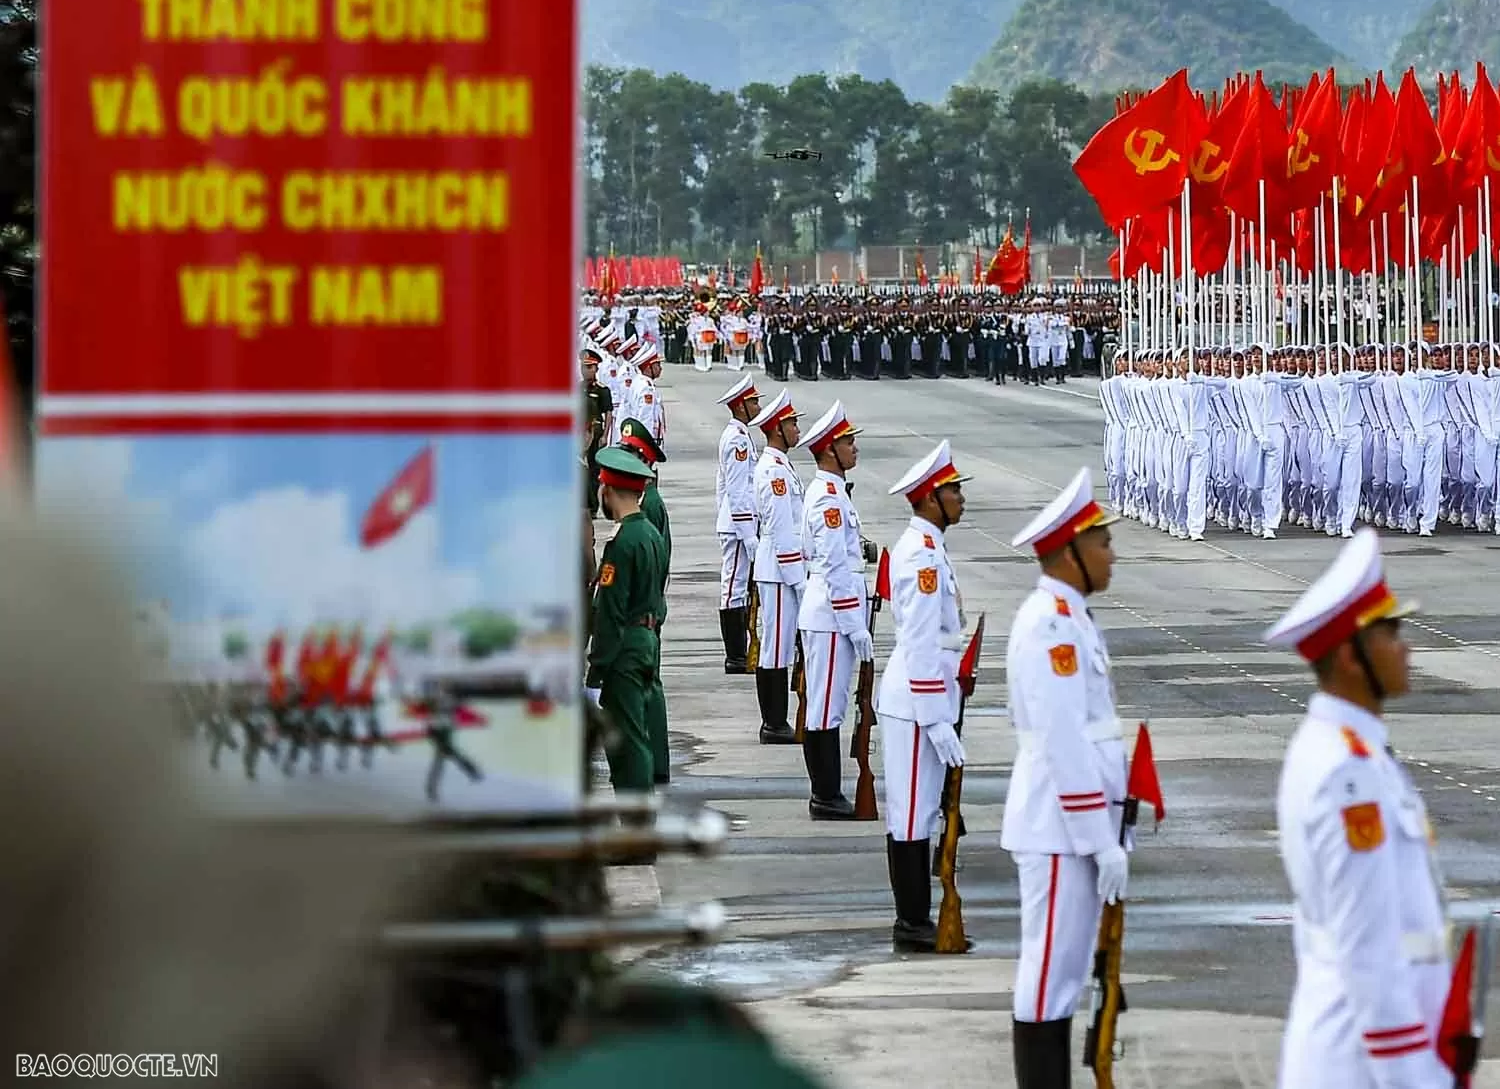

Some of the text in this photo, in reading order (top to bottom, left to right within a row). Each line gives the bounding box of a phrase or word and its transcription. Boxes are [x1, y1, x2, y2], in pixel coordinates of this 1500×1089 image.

[90, 59, 531, 141] VÀ QUỐC KHÁNH
[113, 162, 509, 231] NƯỚC CHXHCN
[179, 255, 441, 338] VIỆT NAM
